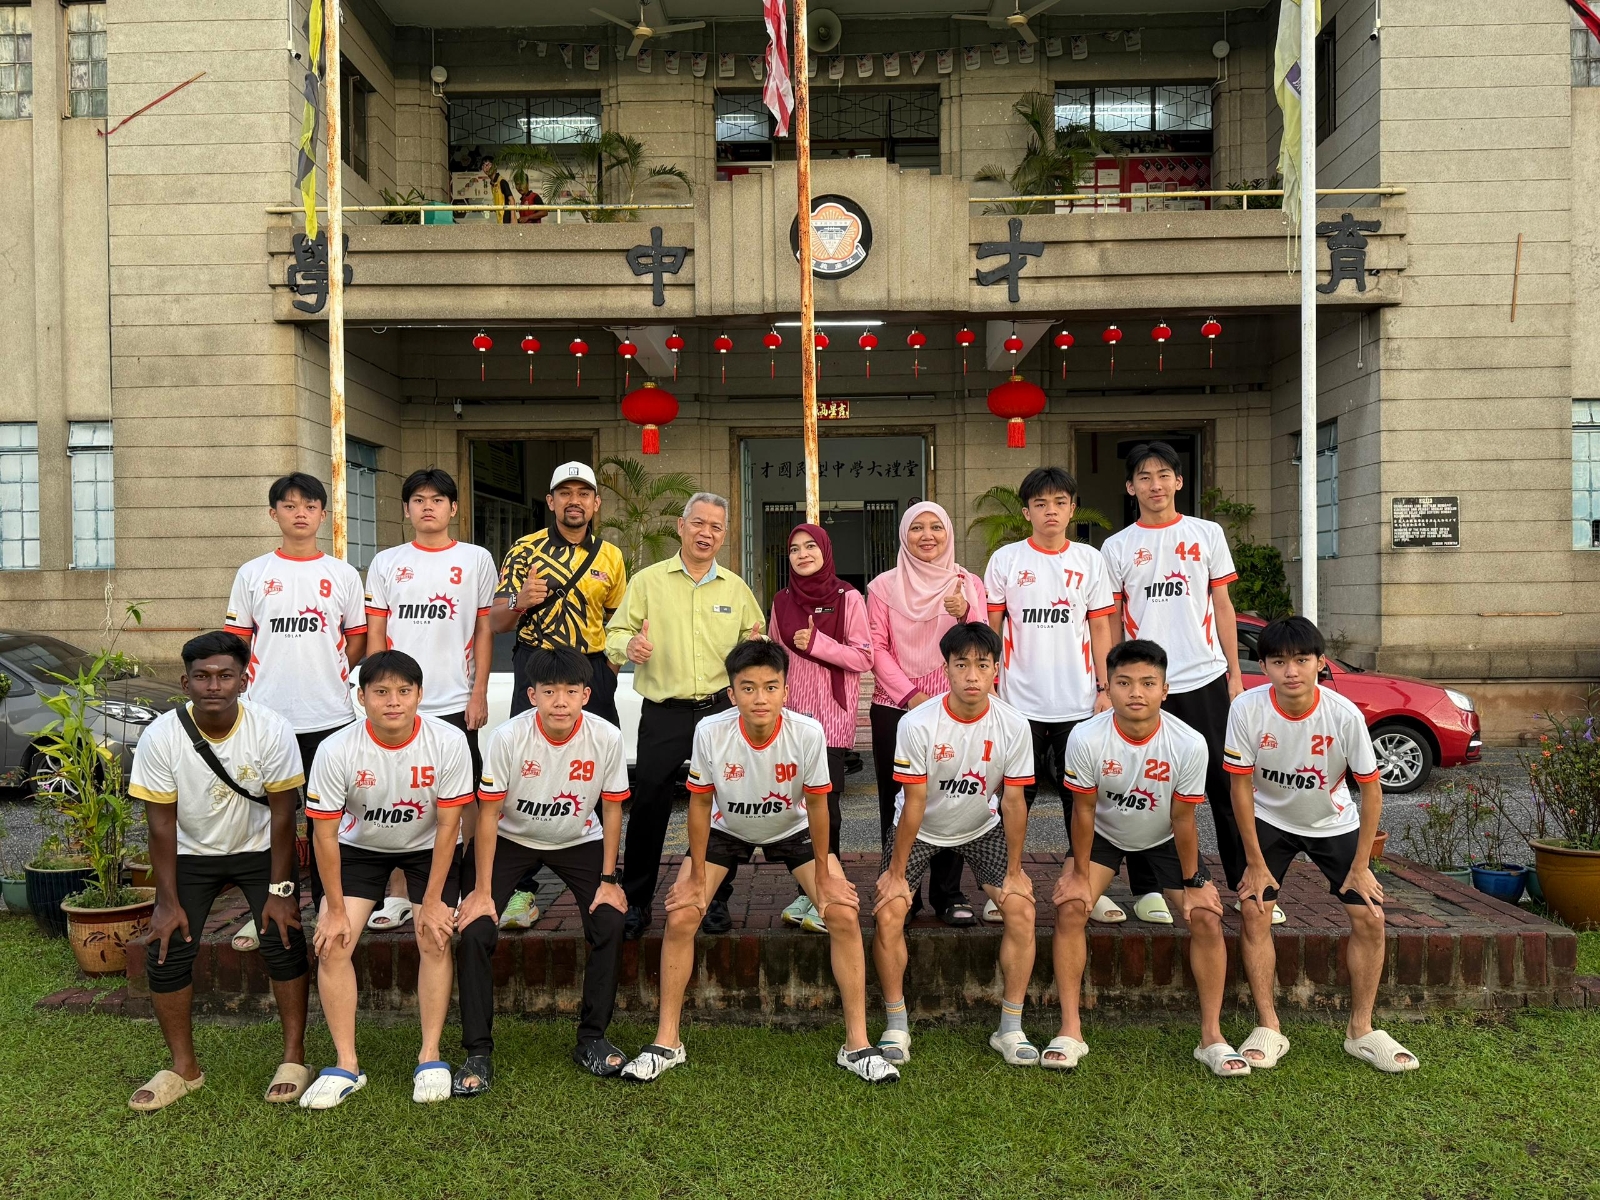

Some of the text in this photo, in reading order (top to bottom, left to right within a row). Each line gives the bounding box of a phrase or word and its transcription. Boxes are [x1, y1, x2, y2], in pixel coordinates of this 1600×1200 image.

[288, 212, 1382, 314] 育 才 中 學
[751, 460, 919, 479] 才國民型中學大禮堂
[1175, 541, 1201, 562] 44
[450, 566, 463, 585] 3
[1063, 568, 1084, 590] 77
[319, 578, 332, 598] 9
[398, 604, 448, 619] TAIYOS
[1022, 608, 1070, 623] TAIYOS
[269, 616, 319, 633] TAIYOS
[981, 739, 994, 762] 1
[410, 766, 435, 788] 15
[569, 759, 595, 781] 29
[775, 762, 798, 784] 90
[1144, 758, 1170, 782] 22
[1260, 767, 1317, 789] TAIYOS
[516, 798, 572, 817] TAIYOS
[727, 801, 783, 815] TAIYOS
